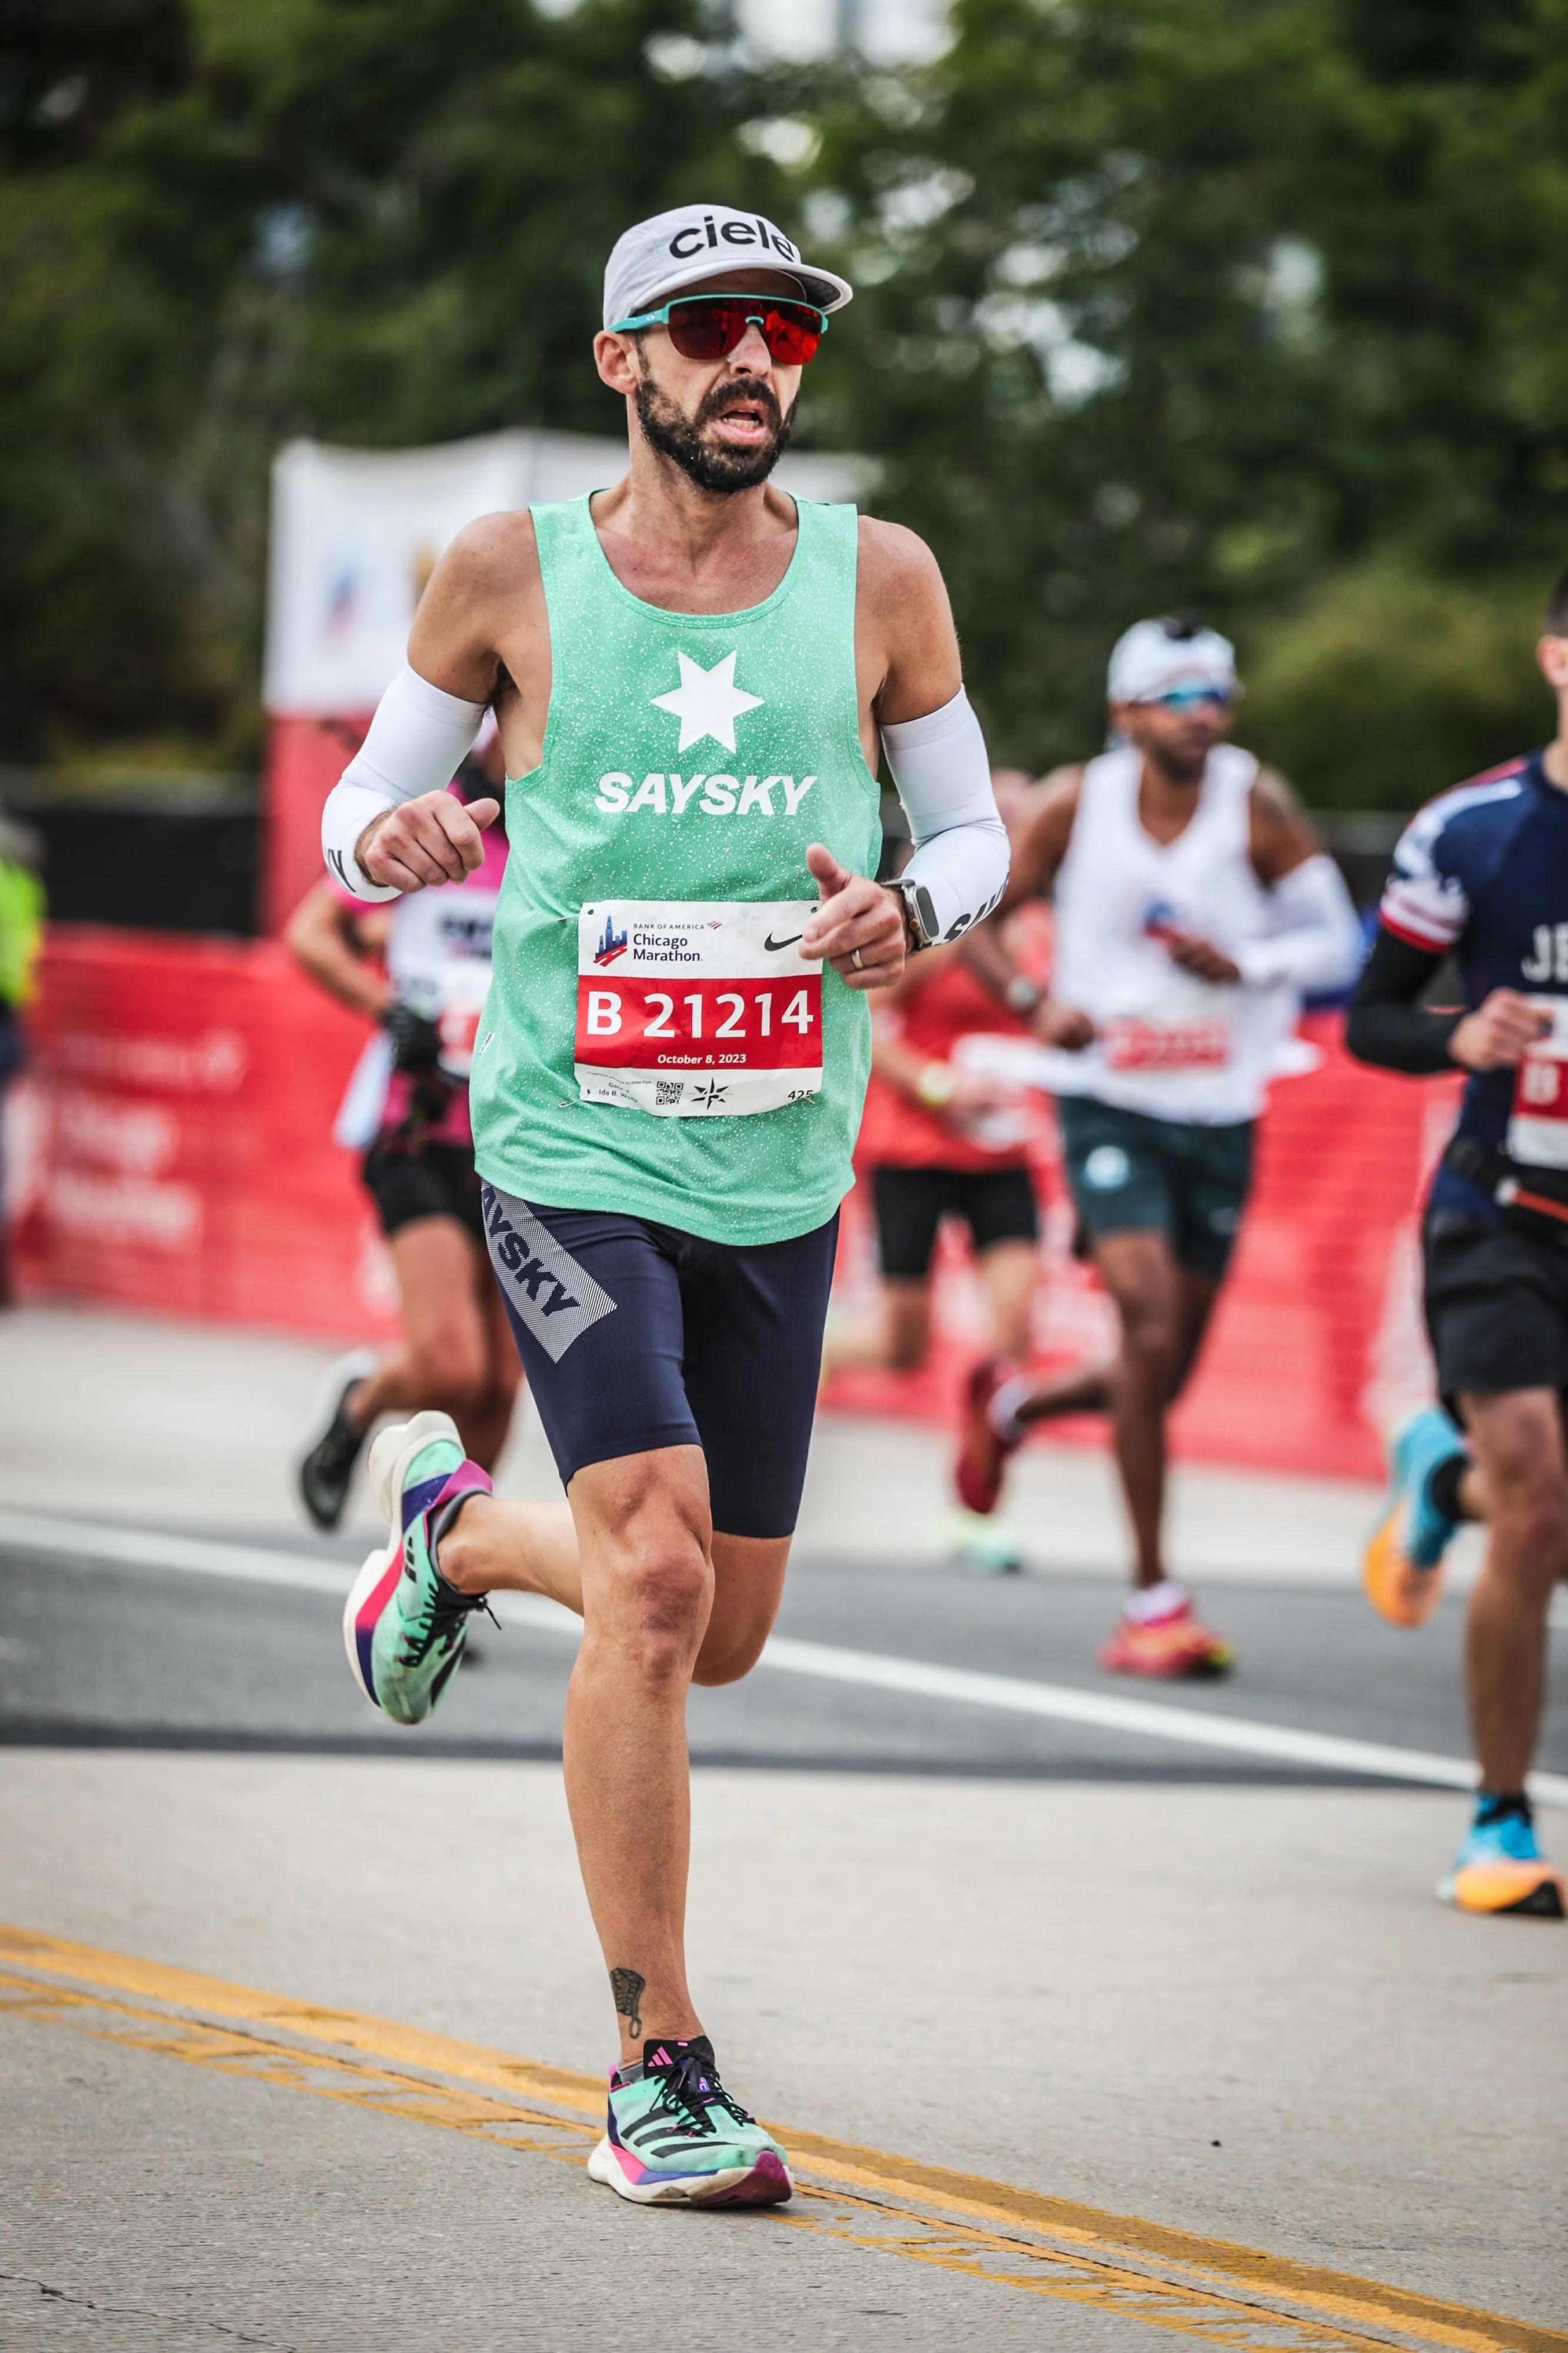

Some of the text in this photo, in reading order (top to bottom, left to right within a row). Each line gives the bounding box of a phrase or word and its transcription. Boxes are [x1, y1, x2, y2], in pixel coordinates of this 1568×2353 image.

[669, 216, 795, 262] ciele
[594, 772, 818, 816] SAYSKY
[633, 934, 688, 949] Chicago
[586, 990, 814, 1038] B 21214
[658, 1054, 746, 1065] October 8, 2023
[787, 1089, 813, 1100] 425
